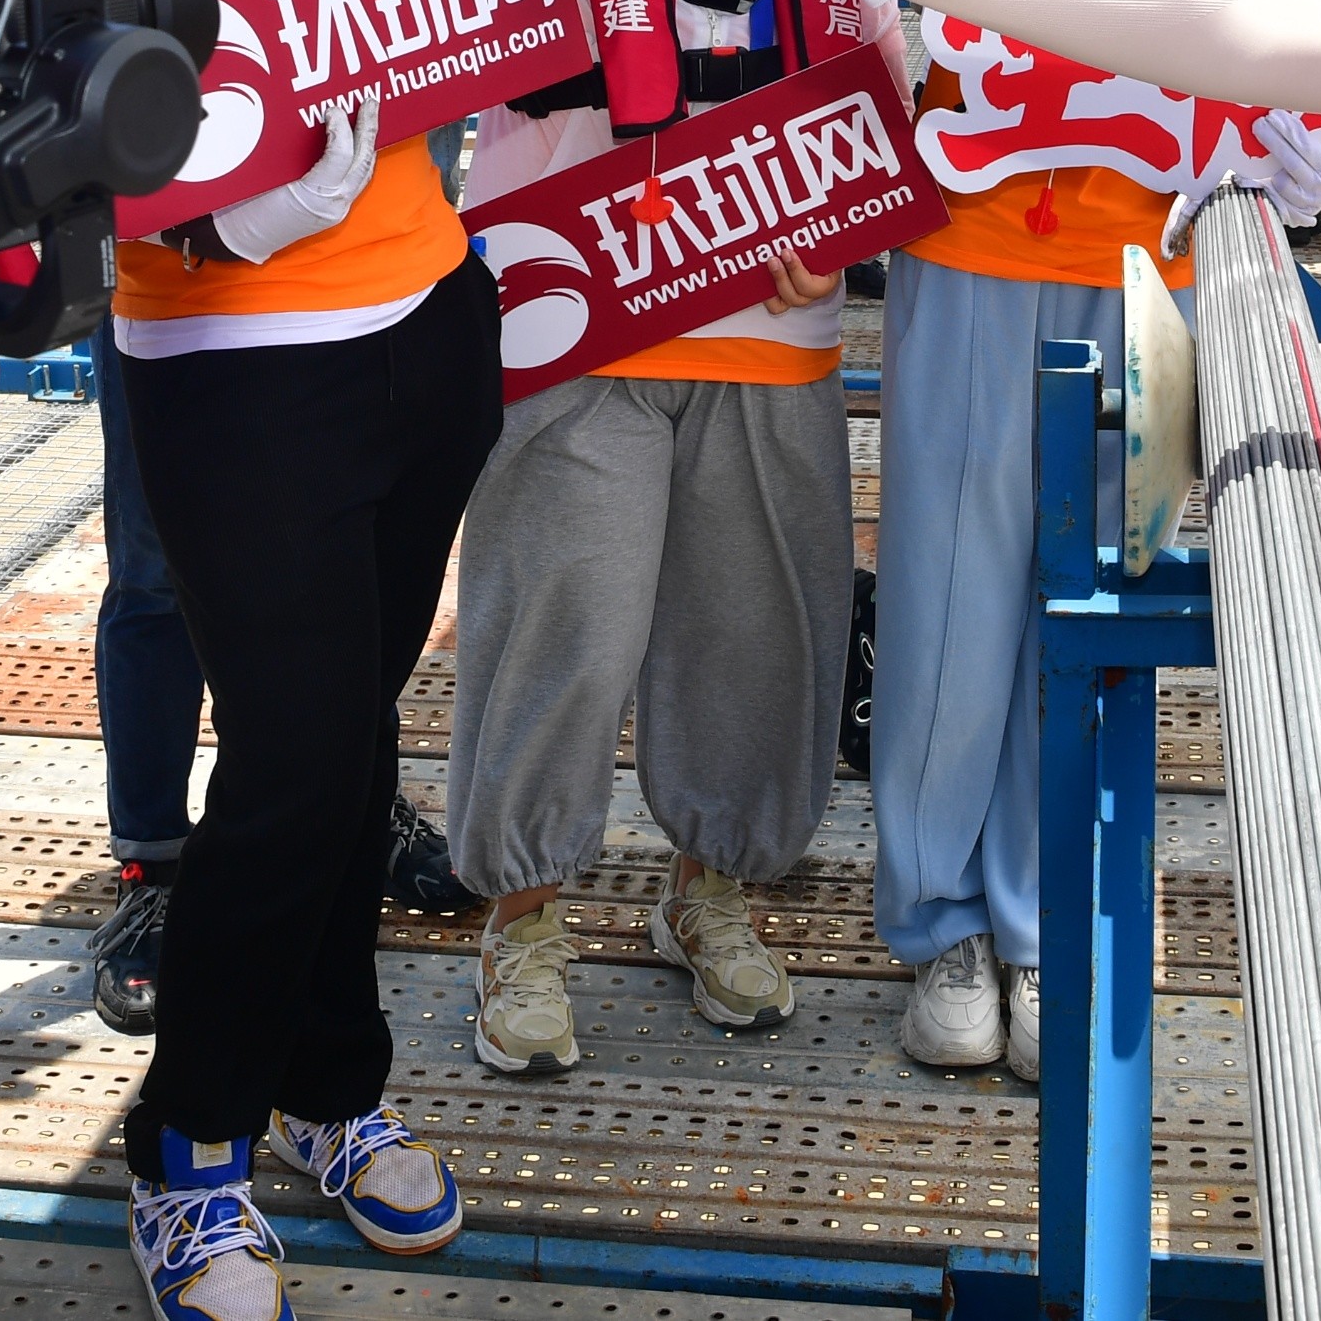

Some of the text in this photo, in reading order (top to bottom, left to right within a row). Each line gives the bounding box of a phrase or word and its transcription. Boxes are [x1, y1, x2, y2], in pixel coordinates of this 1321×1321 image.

[298, 18, 565, 128] www.huanqiu.com
[580, 90, 902, 289] 环球网
[622, 184, 915, 316] www.huanqiu.com
